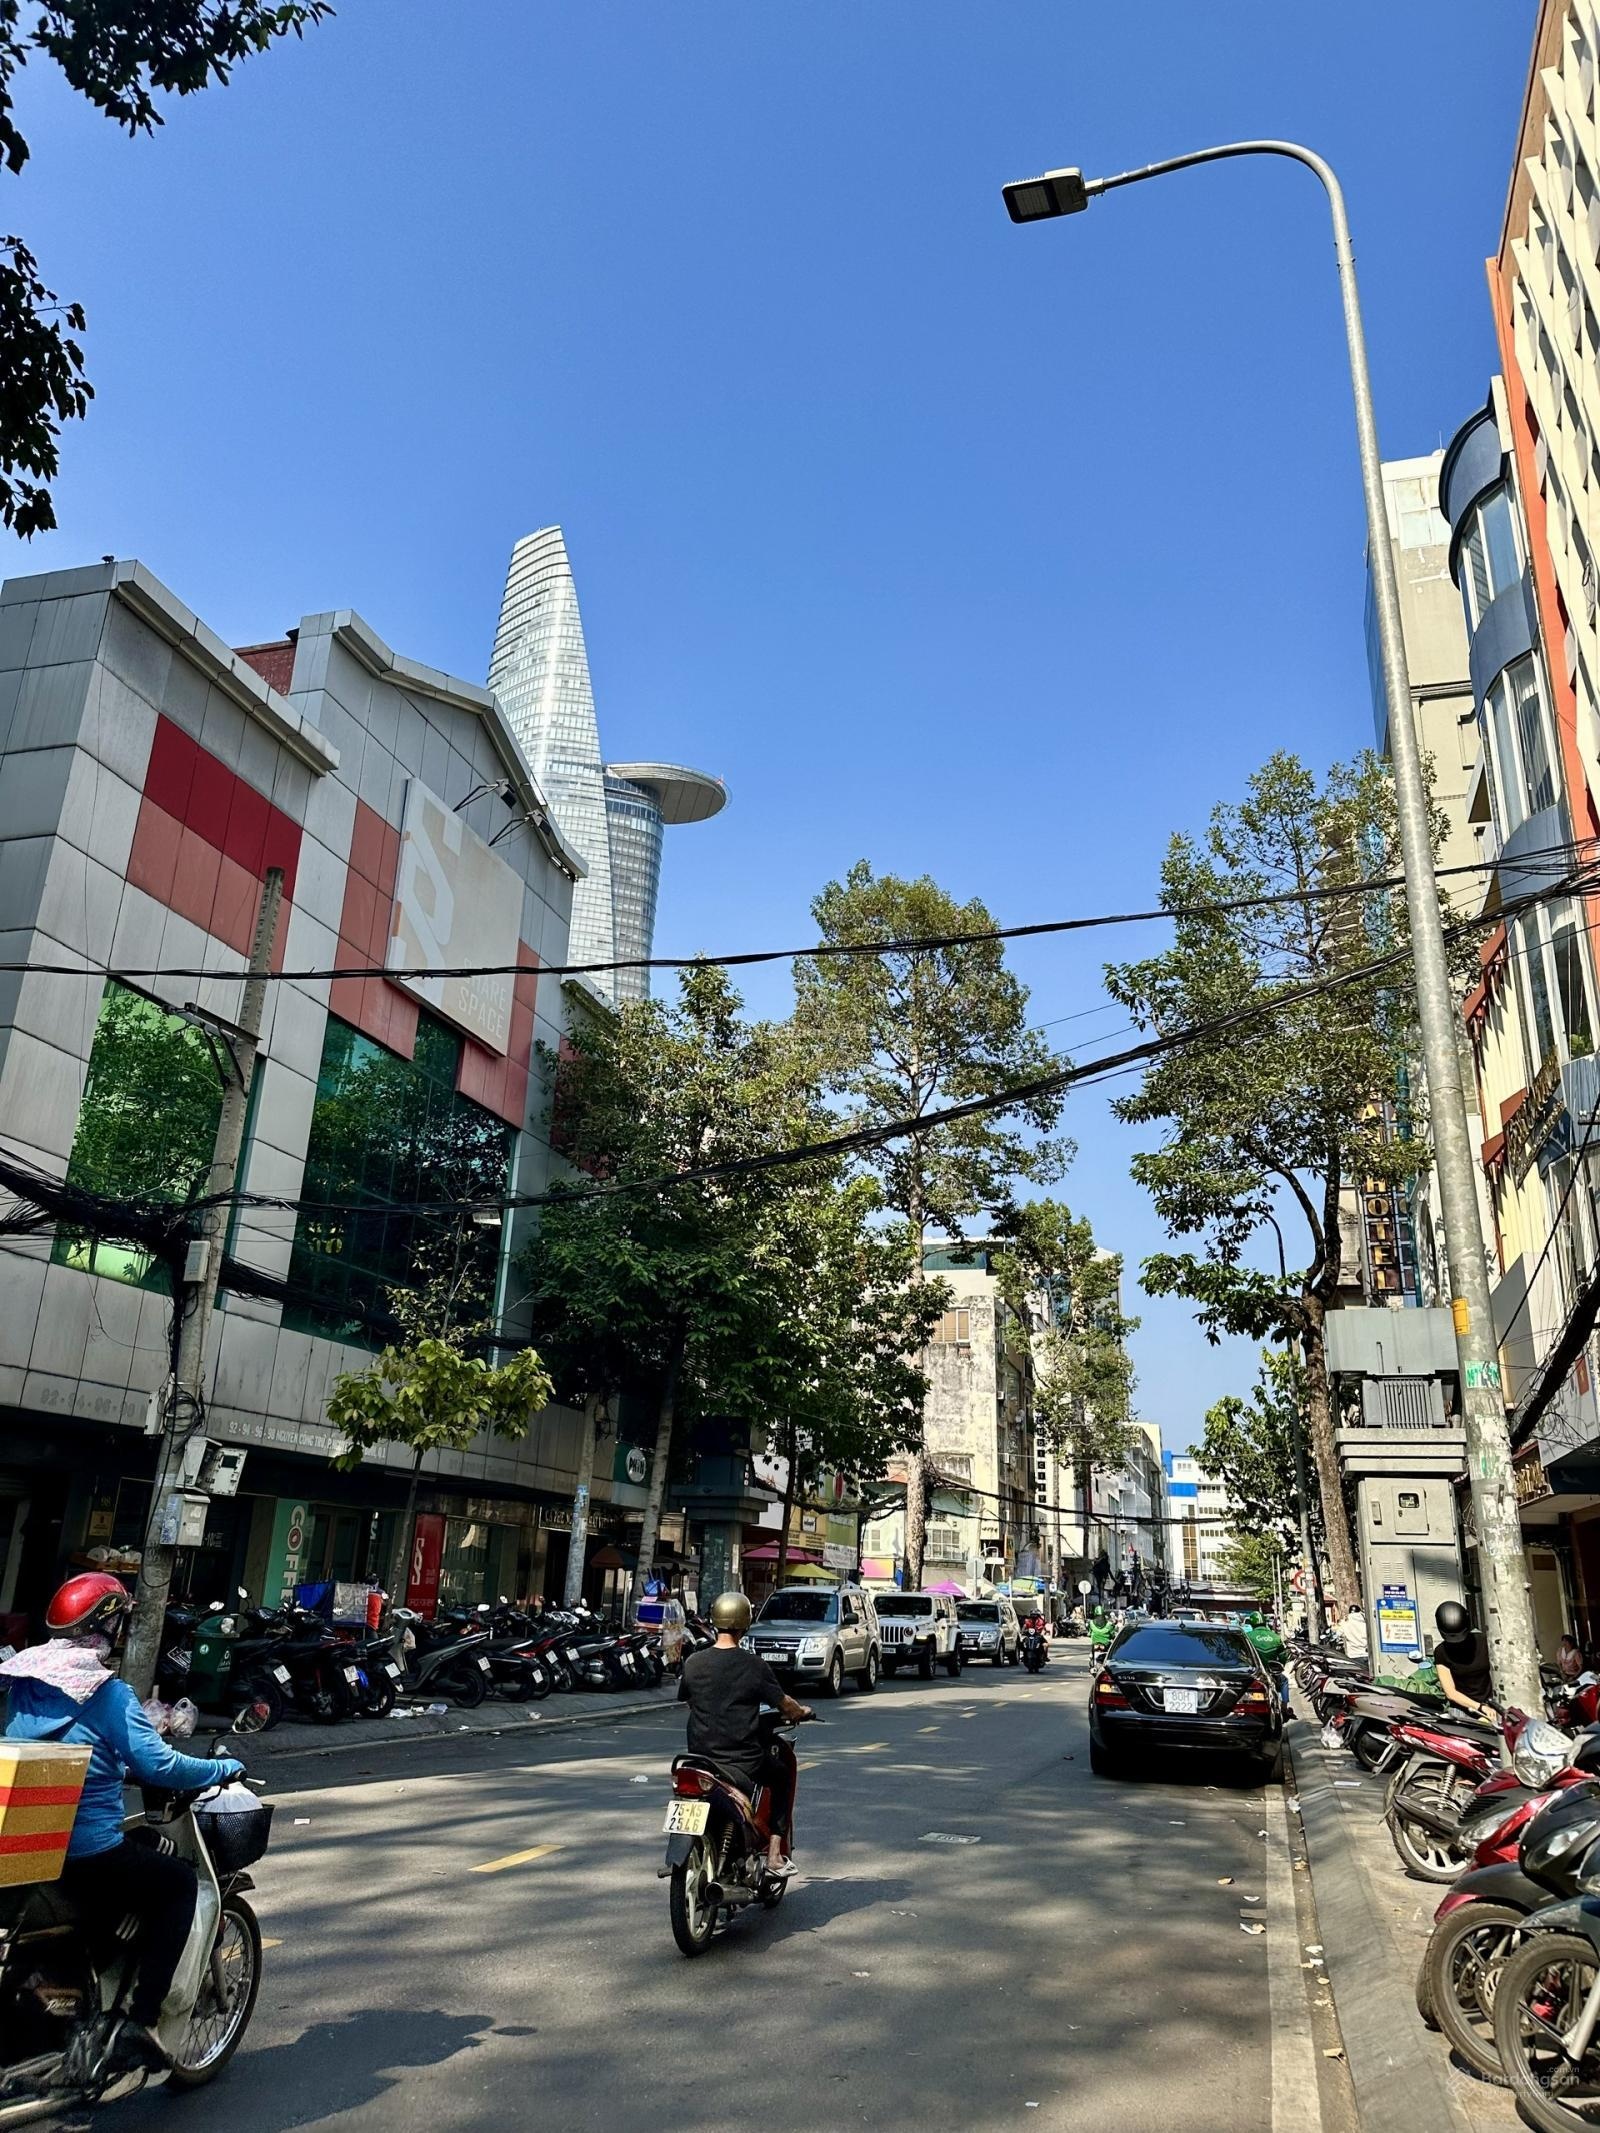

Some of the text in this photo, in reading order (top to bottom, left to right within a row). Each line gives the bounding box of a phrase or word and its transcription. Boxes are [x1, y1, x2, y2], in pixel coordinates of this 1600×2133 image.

[459, 986, 505, 1039] SPACE
[1367, 1175, 1396, 1290] HOTEL
[228, 1421, 239, 1434] 92
[1171, 1691, 1190, 1701] 80H
[1169, 1702, 1193, 1712] 2222
[672, 1803, 703, 1818] 75-K5
[668, 1817, 699, 1832] 2546
